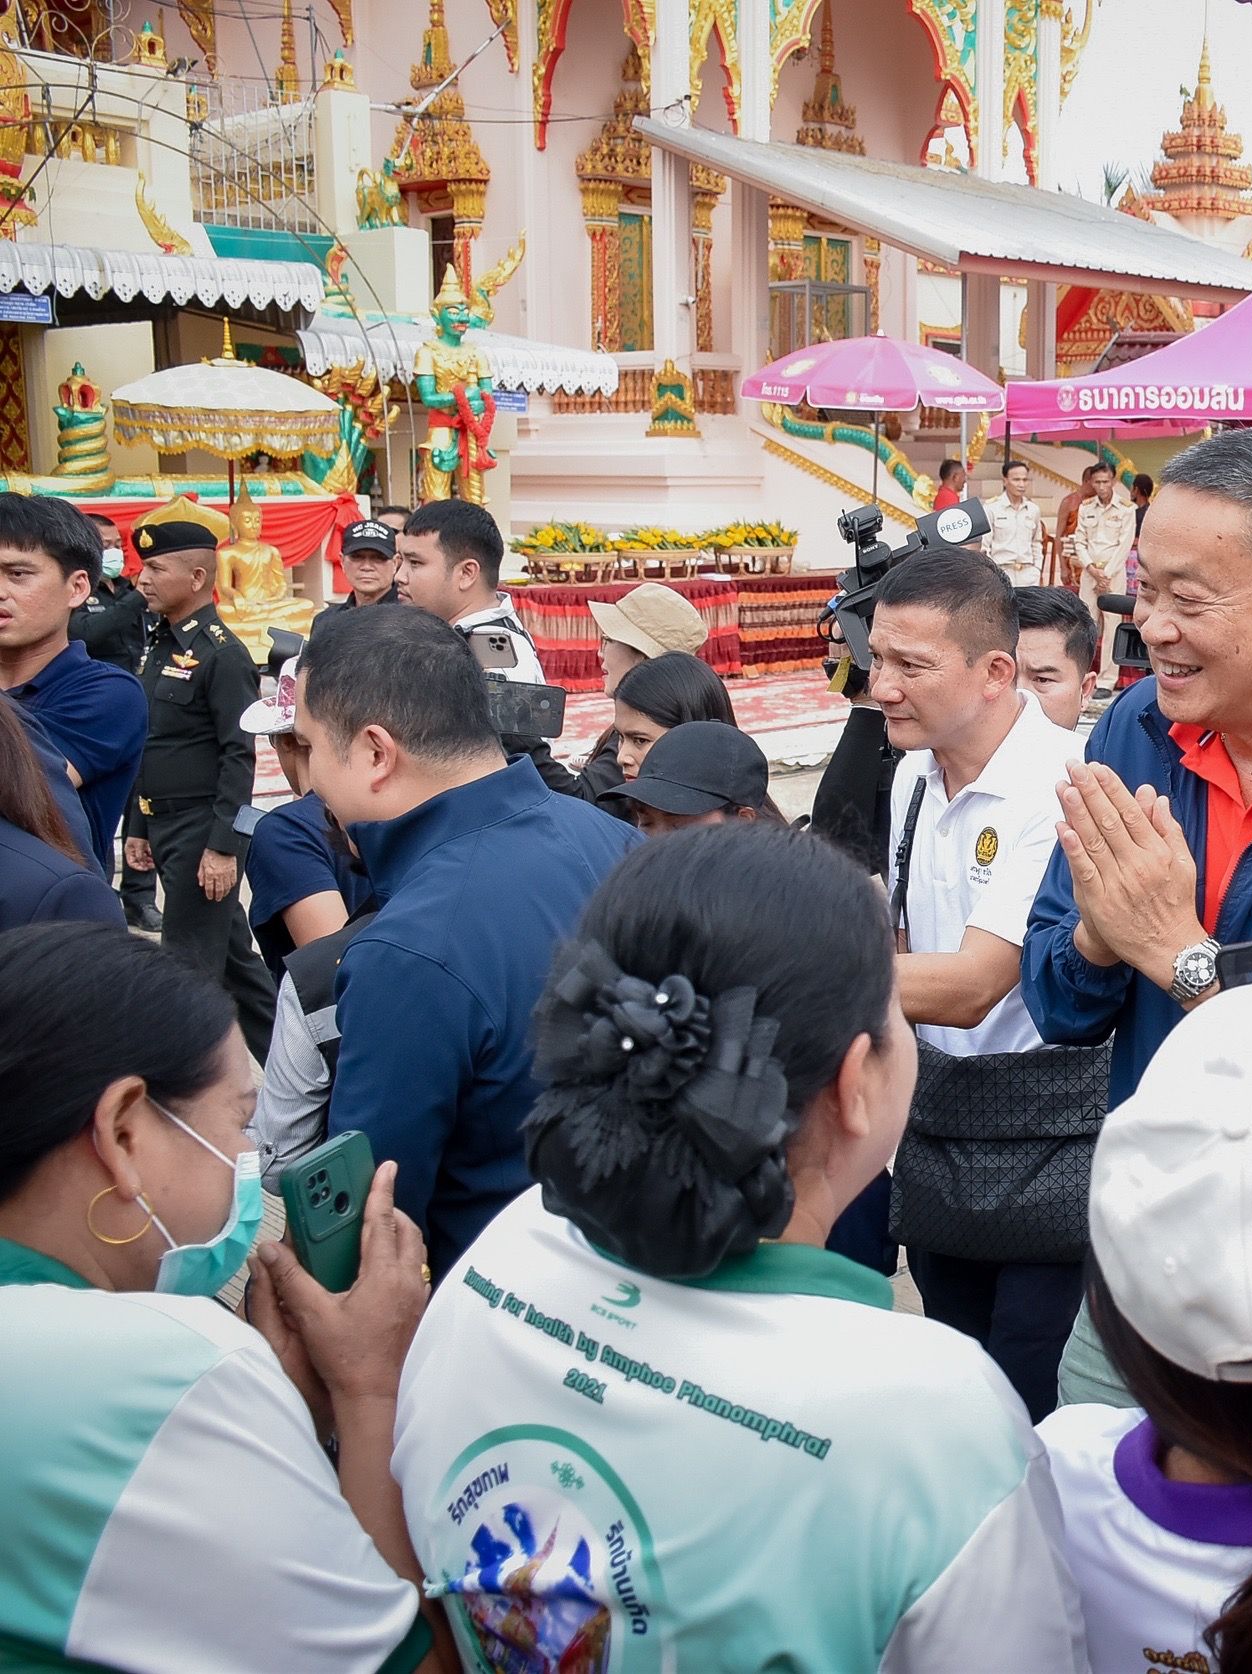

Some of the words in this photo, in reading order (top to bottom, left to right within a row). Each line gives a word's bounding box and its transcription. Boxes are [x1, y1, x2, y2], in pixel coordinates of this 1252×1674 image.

[1078, 384, 1245, 412] ธนาคารออมสิน
[940, 518, 969, 533] PRESS
[462, 1266, 504, 1308] Running
[502, 1292, 527, 1318] for
[524, 1304, 576, 1347] health
[576, 1331, 600, 1362] by
[600, 1344, 677, 1394] Amphoe
[676, 1379, 833, 1460] Phanomphrai
[446, 1462, 510, 1526] รักสุขภาพ
[605, 1519, 650, 1635] รักบ้านเกิด
